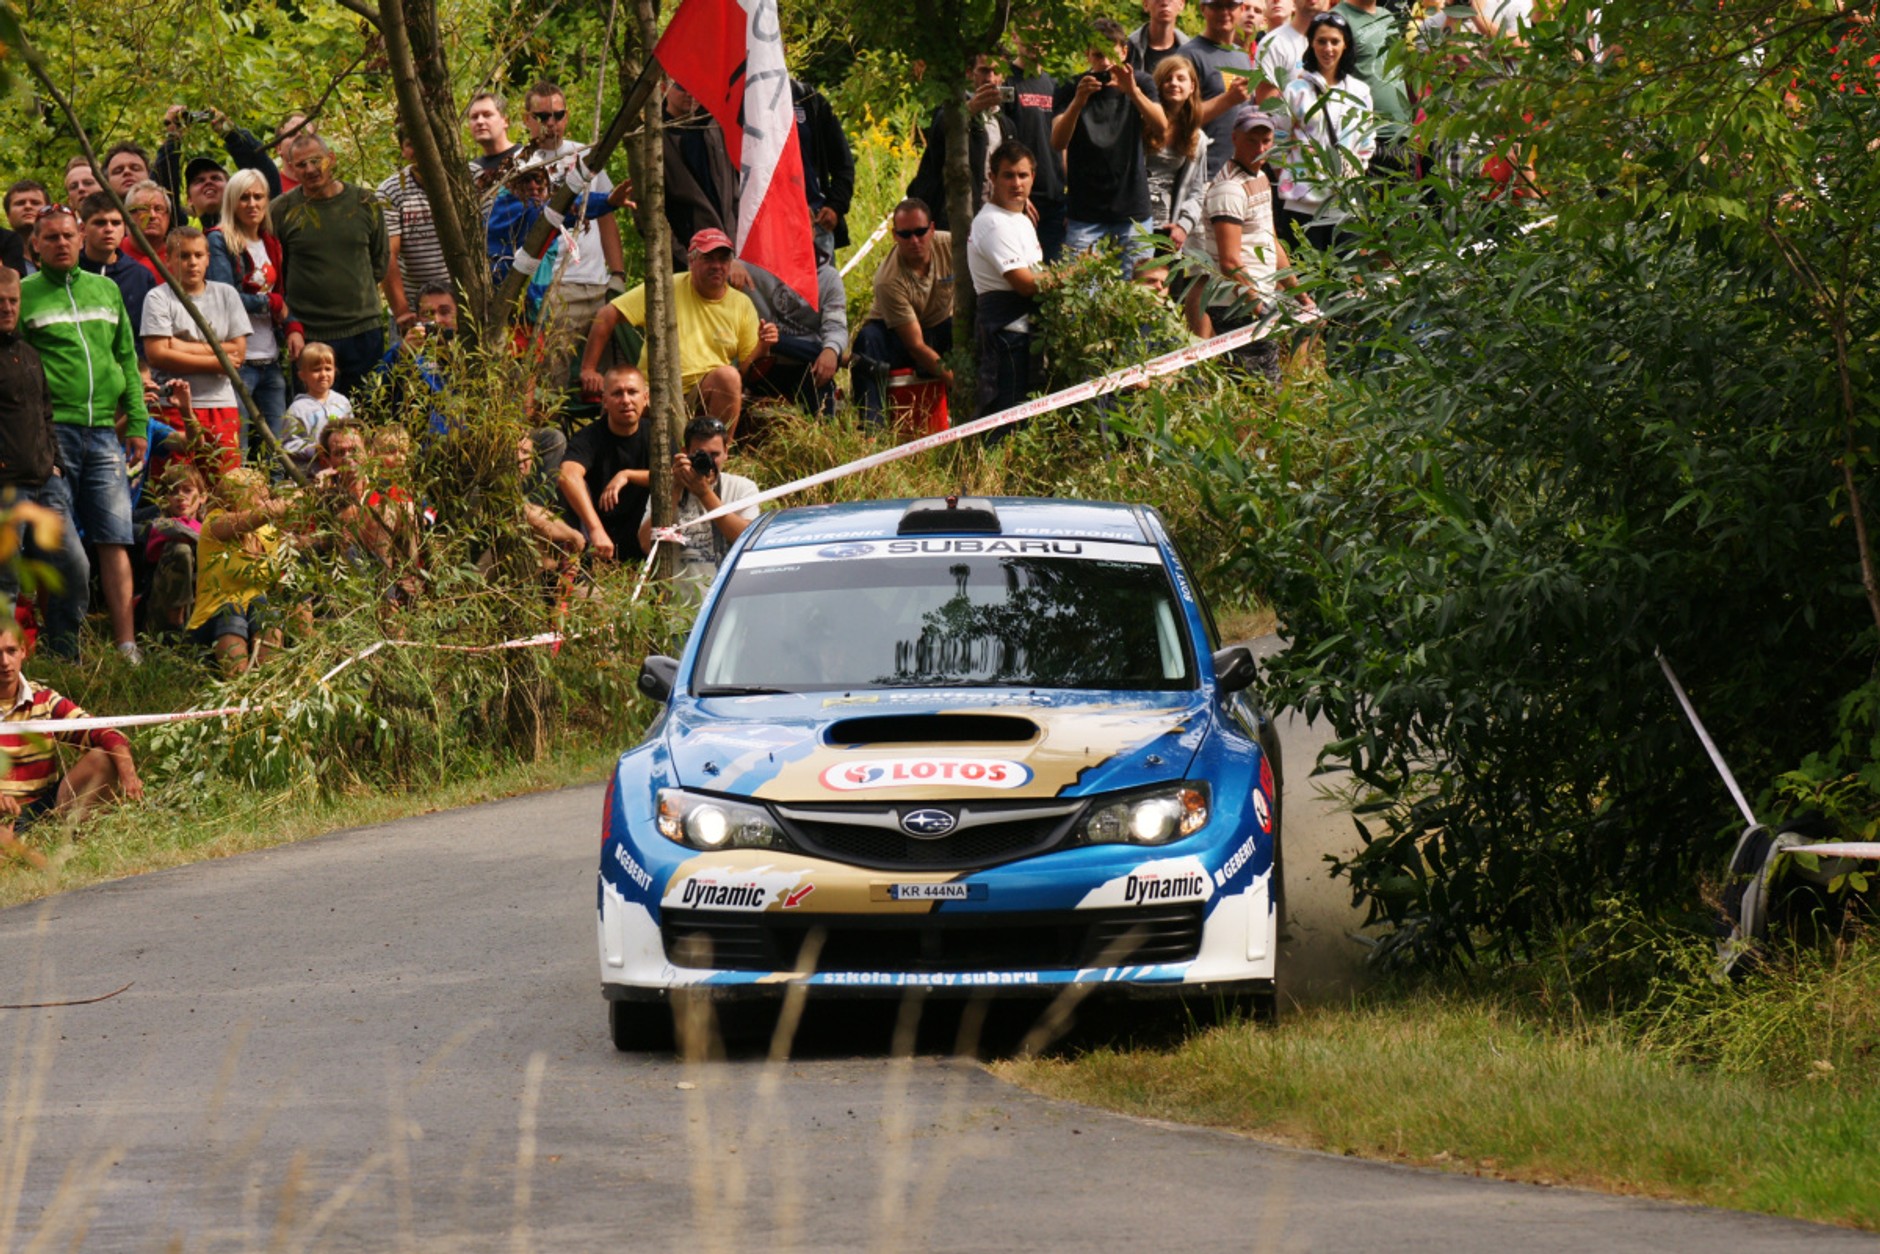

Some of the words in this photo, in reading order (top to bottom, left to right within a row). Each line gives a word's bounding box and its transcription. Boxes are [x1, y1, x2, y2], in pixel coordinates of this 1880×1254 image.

[1014, 527, 1134, 540] KERATRONIK
[887, 540, 1083, 555] SUBARU
[892, 762, 1007, 781] LOTOS
[1222, 836, 1257, 880] GEBERIT
[619, 849, 654, 892] GEBERIT
[682, 878, 766, 908] Dynamic
[901, 883, 921, 897] KR
[924, 883, 965, 897] 444NA
[1125, 874, 1203, 905] Dynamic
[896, 971, 957, 986] jazdy
[961, 970, 1039, 985] subaru
